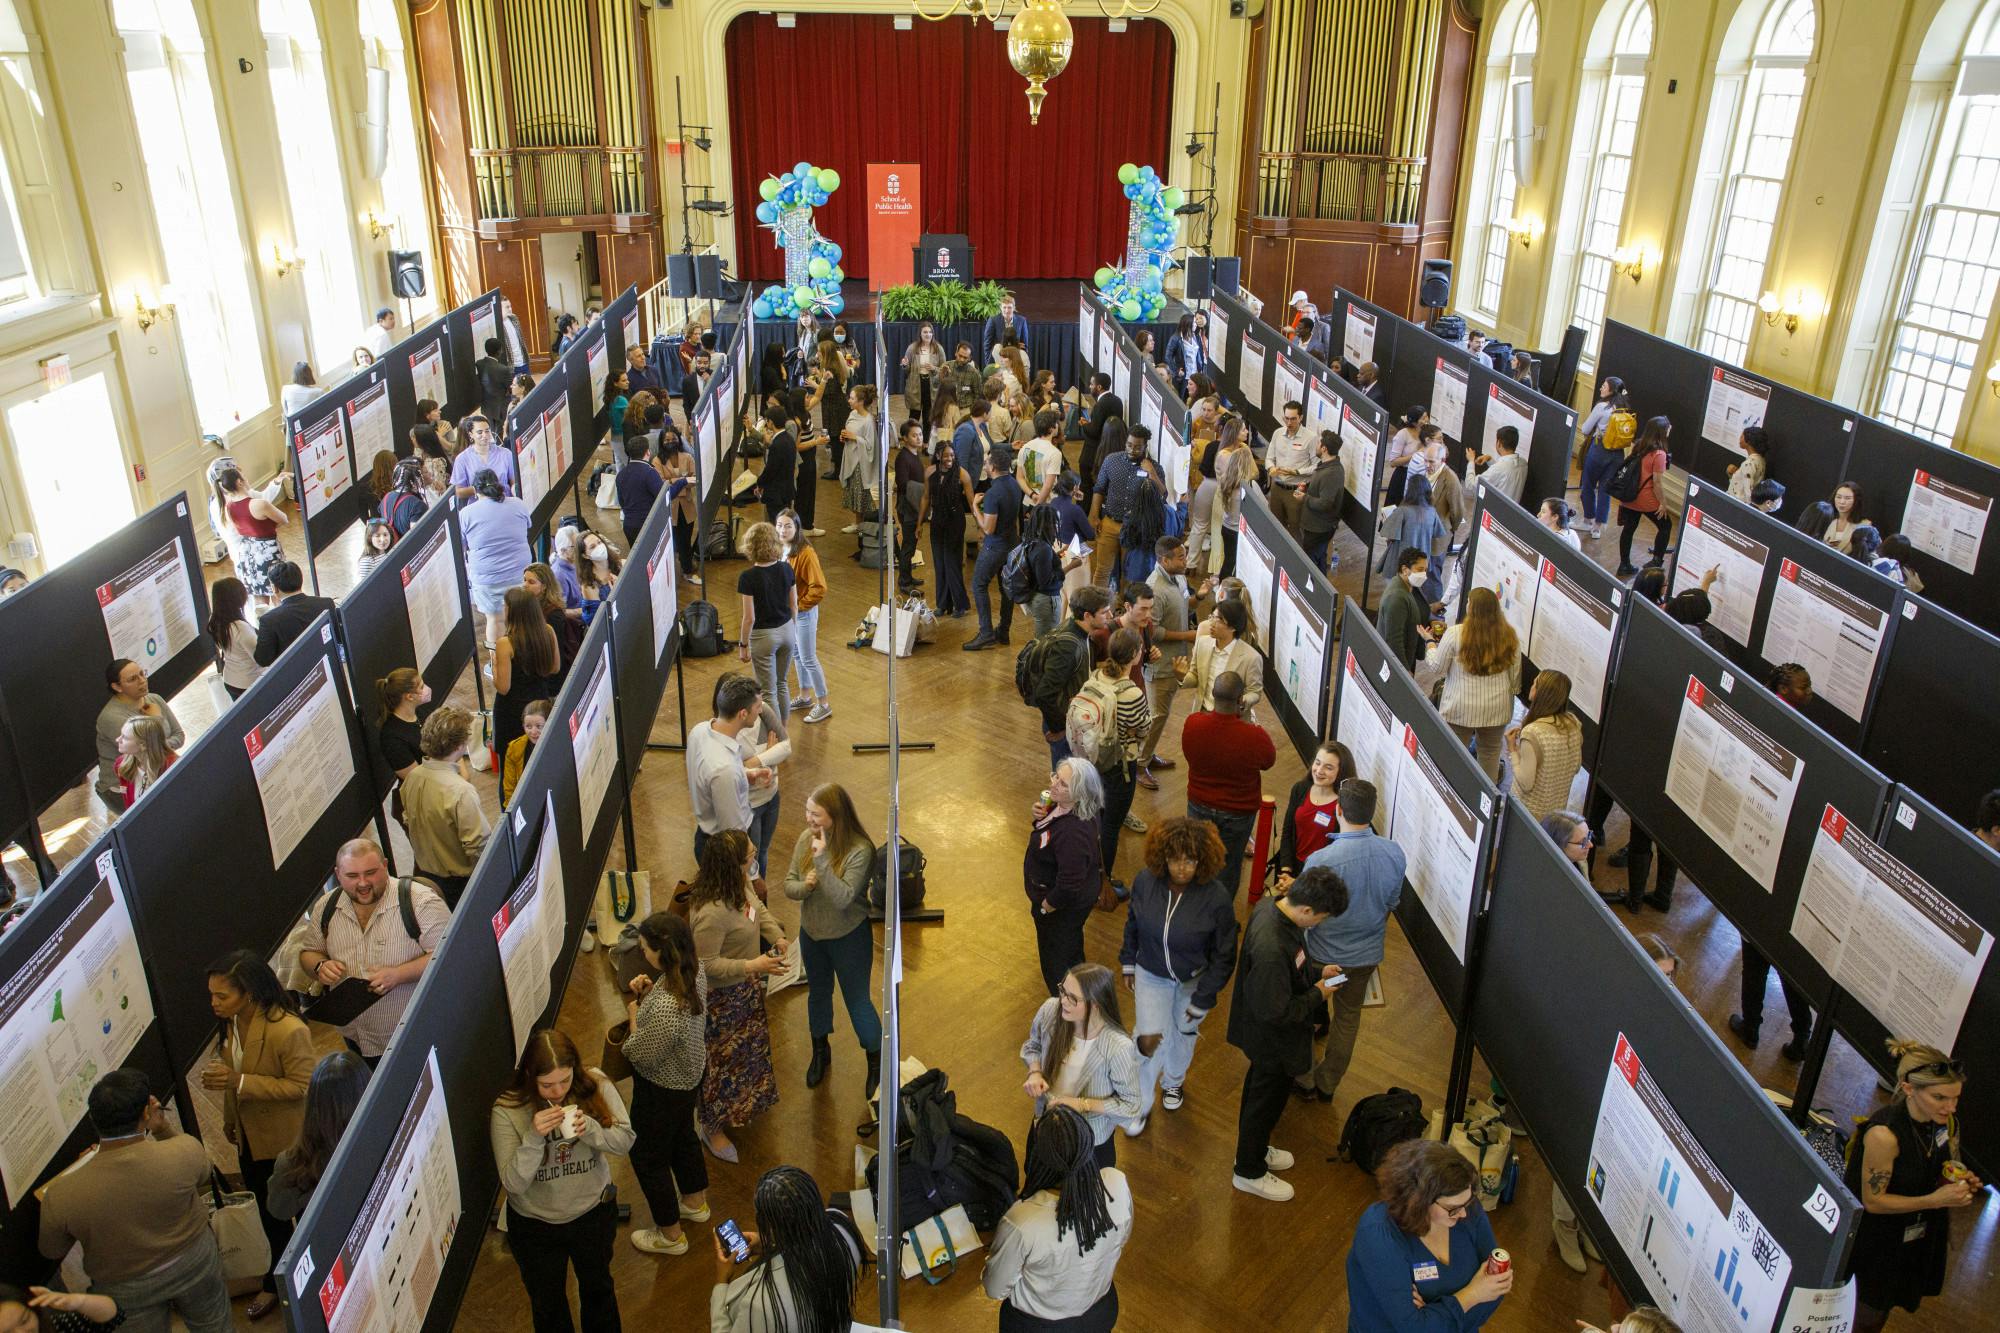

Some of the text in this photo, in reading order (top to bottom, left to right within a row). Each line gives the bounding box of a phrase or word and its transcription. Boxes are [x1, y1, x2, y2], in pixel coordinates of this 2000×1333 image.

[1899, 806, 1914, 824] 115
[98, 853, 111, 874] 55
[1887, 859, 1896, 869] Use
[1901, 870, 1913, 882] Race
[1912, 879, 1922, 889] and
[1920, 886, 1940, 904] Ethnicity
[1943, 905, 1959, 919] Adults
[1957, 916, 1971, 928] from
[1904, 881, 1920, 896] Length
[1923, 897, 1935, 908] Stay
[1938, 908, 1947, 917] the
[1945, 914, 1956, 925] U.S.
[1811, 1193, 1836, 1224] 94
[1807, 1314, 1841, 1322] Posters
[1827, 1322, 1848, 1333] 113
